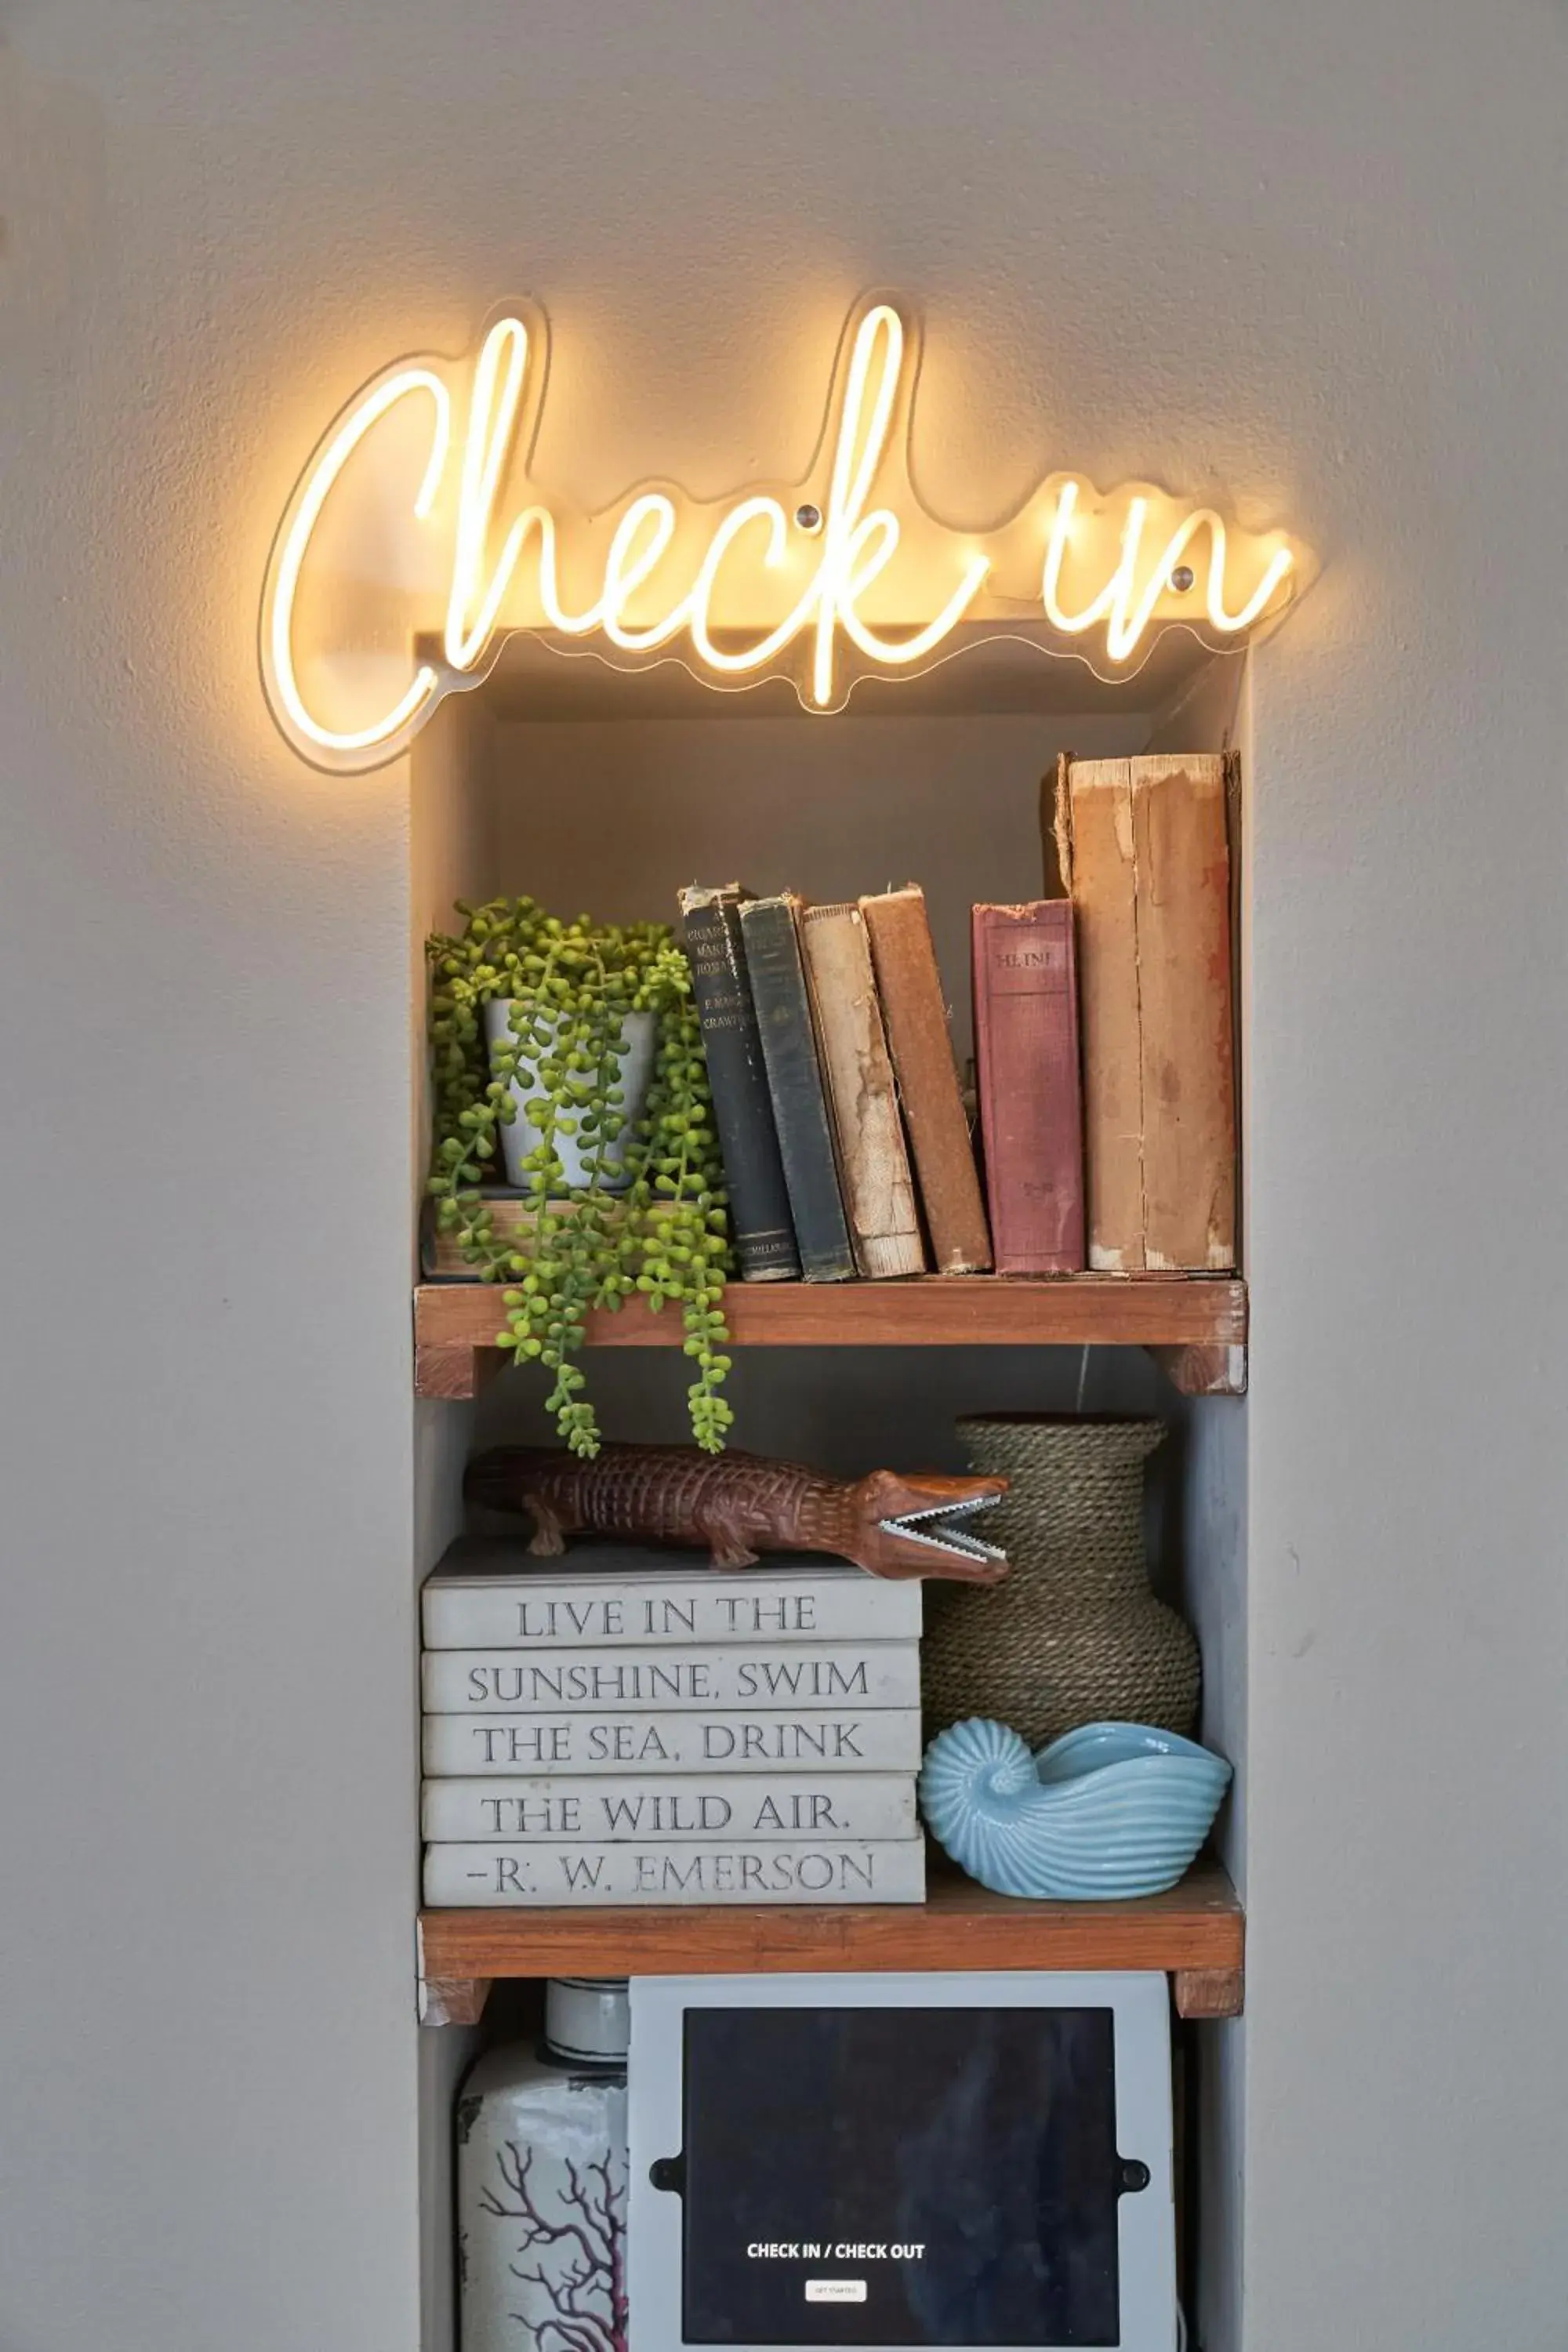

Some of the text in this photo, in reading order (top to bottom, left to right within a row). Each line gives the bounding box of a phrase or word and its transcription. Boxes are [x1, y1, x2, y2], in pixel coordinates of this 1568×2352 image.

[272, 303, 1292, 749] Check in
[517, 1595, 817, 1637] LIVE IN THE
[467, 1660, 870, 1702] SUNSHINE, SWIM
[473, 1722, 866, 1762] THE SEA, DRINK
[481, 1794, 851, 1834] THE WILD AIR.
[558, 1855, 613, 1893] W.
[632, 1853, 875, 1893] EMERSON
[747, 2243, 926, 2259] CHECK IN / CHECK OUT
